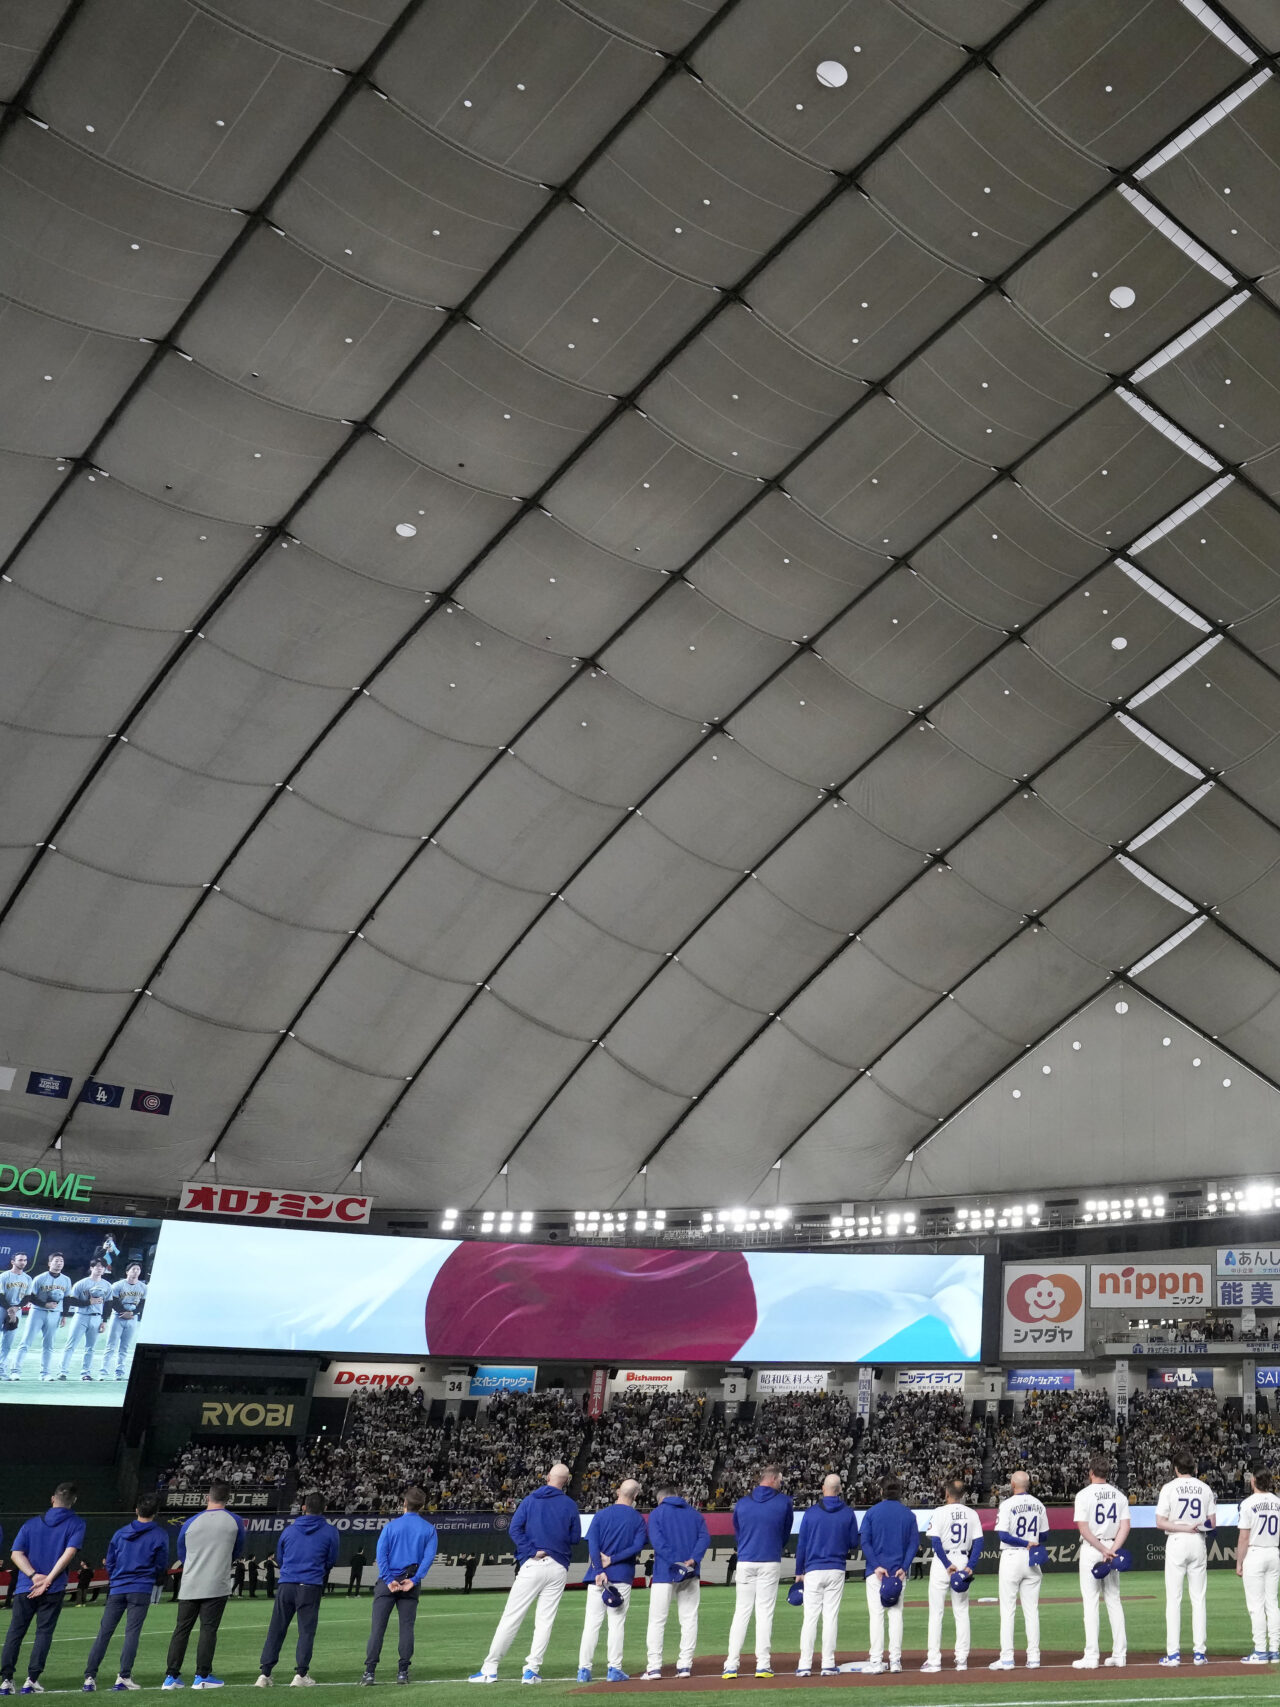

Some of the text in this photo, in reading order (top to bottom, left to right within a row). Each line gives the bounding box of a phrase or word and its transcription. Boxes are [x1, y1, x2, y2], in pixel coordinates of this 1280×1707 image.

[0, 1164, 96, 1203] DOME
[184, 1186, 367, 1222] オロナミンC
[1098, 1267, 1204, 1300] nippn
[1172, 1296, 1204, 1305] ニップン
[1013, 1325, 1073, 1344] シマダヤ
[333, 1371, 415, 1389] Denyo
[626, 1372, 673, 1382] Bishamon
[760, 1373, 824, 1385] 昭和医科大学
[898, 1372, 963, 1384] ニッテイライフ
[448, 1382, 462, 1392] 34
[730, 1384, 736, 1394] 3
[990, 1383, 996, 1393] 1
[201, 1402, 295, 1427] RYOBI
[1094, 1491, 1116, 1501] SAUER
[1176, 1486, 1203, 1495] FRASSO
[1010, 1504, 1043, 1515] WOODWARD
[1095, 1502, 1118, 1525] 64
[1178, 1498, 1202, 1519] 79
[951, 1511, 968, 1521] EBEL
[250, 1518, 285, 1531] MLB
[1015, 1516, 1038, 1538] 84
[1258, 1514, 1278, 1536] 70
[950, 1523, 968, 1544] 91
